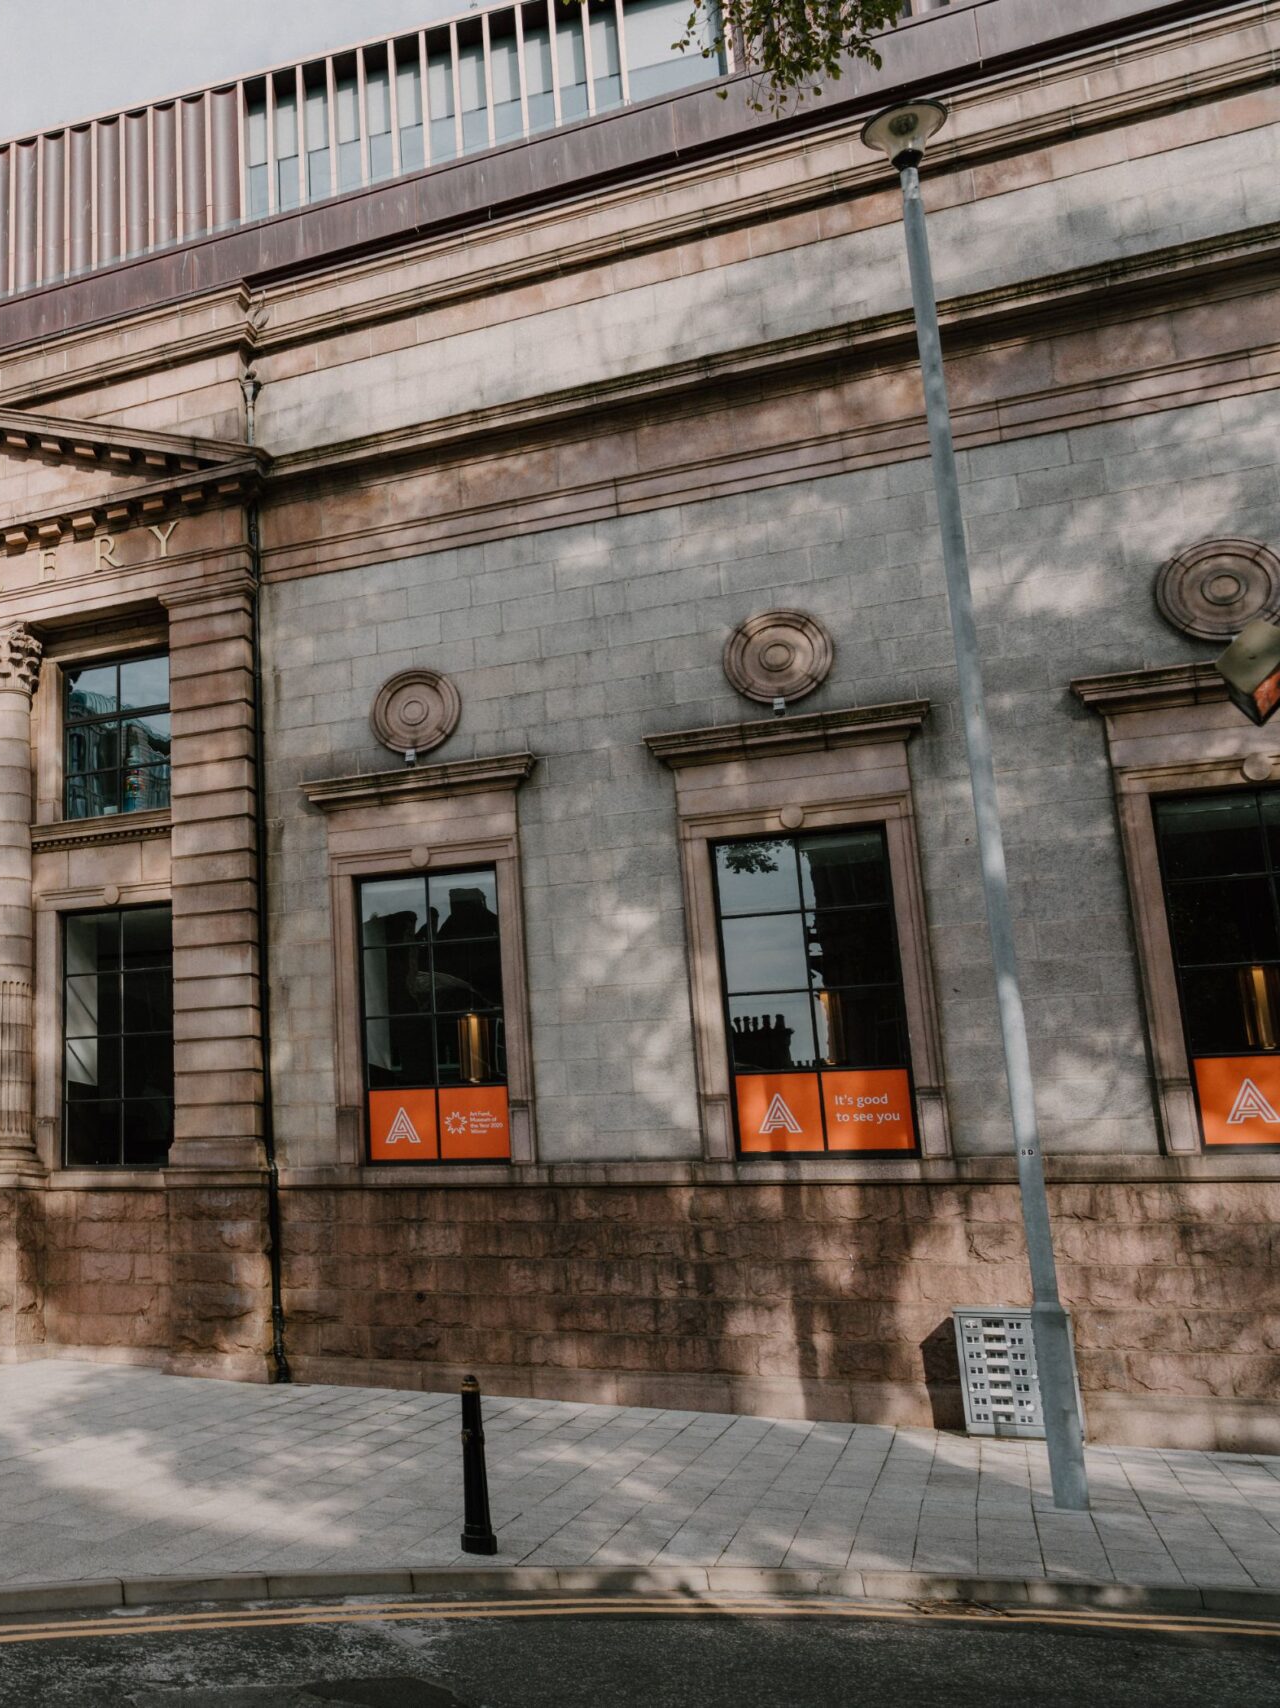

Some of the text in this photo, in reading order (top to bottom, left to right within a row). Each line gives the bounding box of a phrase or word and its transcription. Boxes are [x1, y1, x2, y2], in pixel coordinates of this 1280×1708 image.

[834, 1094, 888, 1108] It's good
[836, 1112, 900, 1124] to see you
